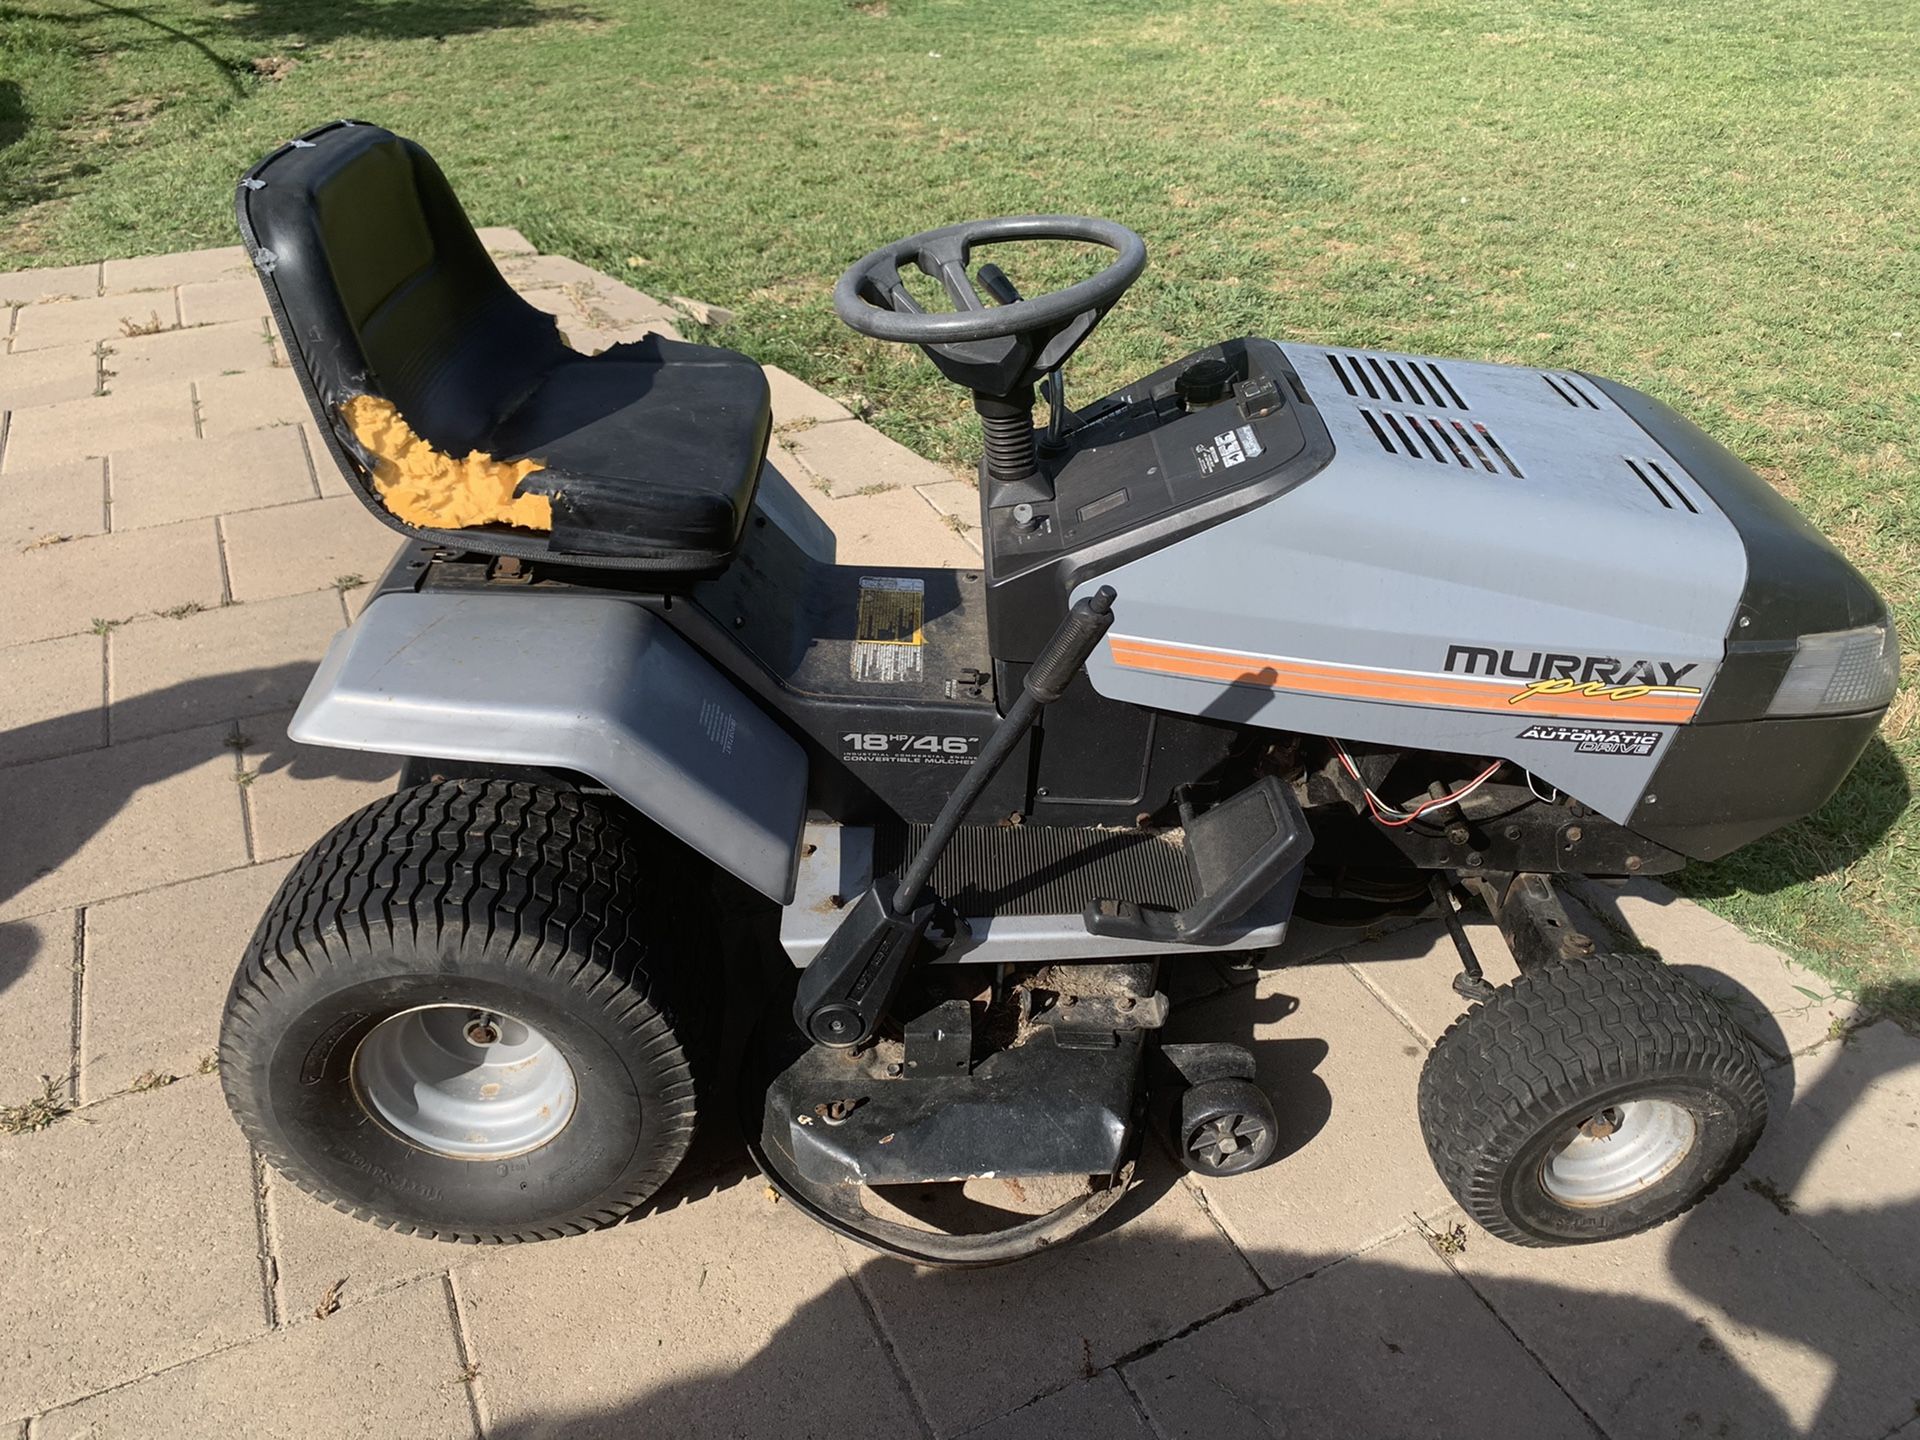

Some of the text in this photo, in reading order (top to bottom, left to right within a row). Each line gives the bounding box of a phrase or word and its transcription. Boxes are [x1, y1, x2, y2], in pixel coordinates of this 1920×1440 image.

[1444, 645, 1699, 687] MURRAY
[1508, 677, 1701, 705] pro
[1522, 730, 1657, 745] AUTOMATIC
[1533, 725, 1659, 737] HYDROSTATIC
[1578, 741, 1652, 755] DRIVE
